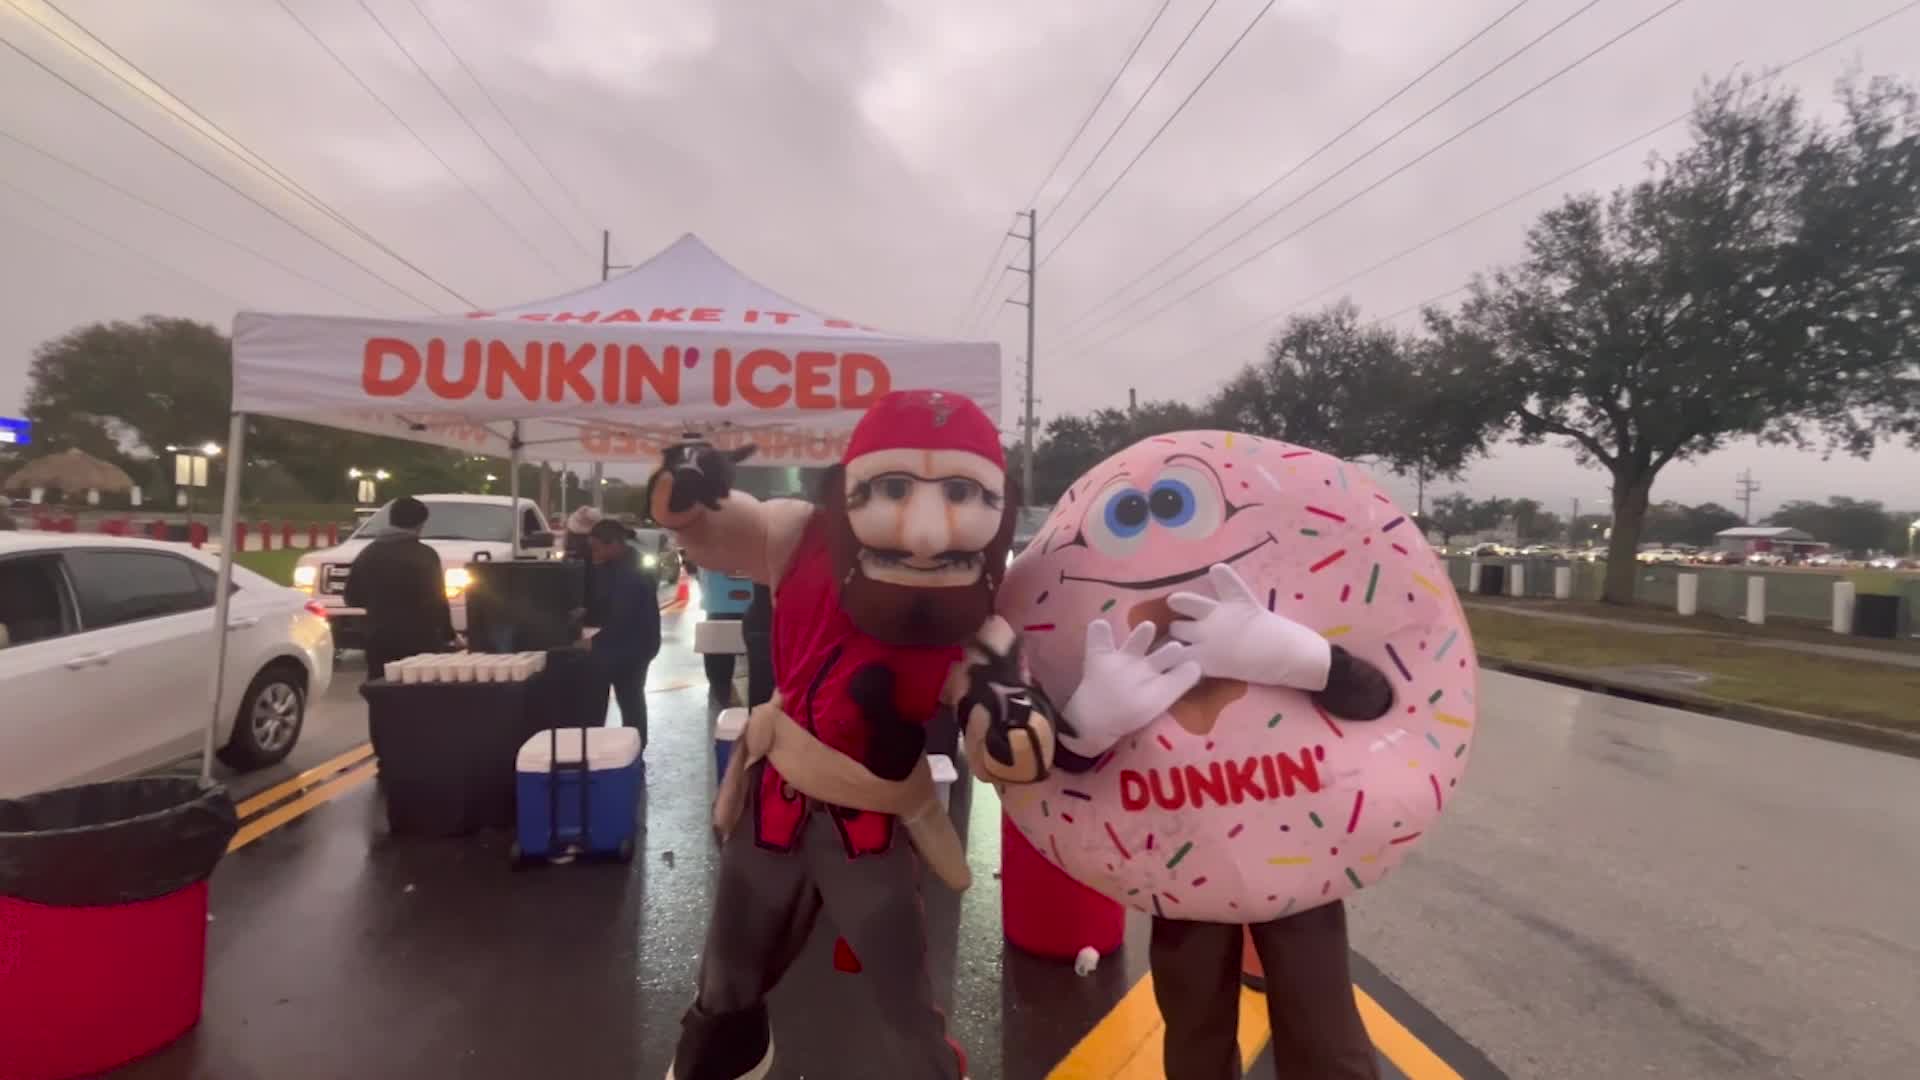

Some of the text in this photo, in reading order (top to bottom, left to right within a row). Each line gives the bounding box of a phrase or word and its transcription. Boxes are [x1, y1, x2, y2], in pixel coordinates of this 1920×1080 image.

[743, 311, 801, 325] IT
[362, 337, 892, 409] DUNKIN' ICED
[1120, 745, 1325, 811] DUNKIN'
